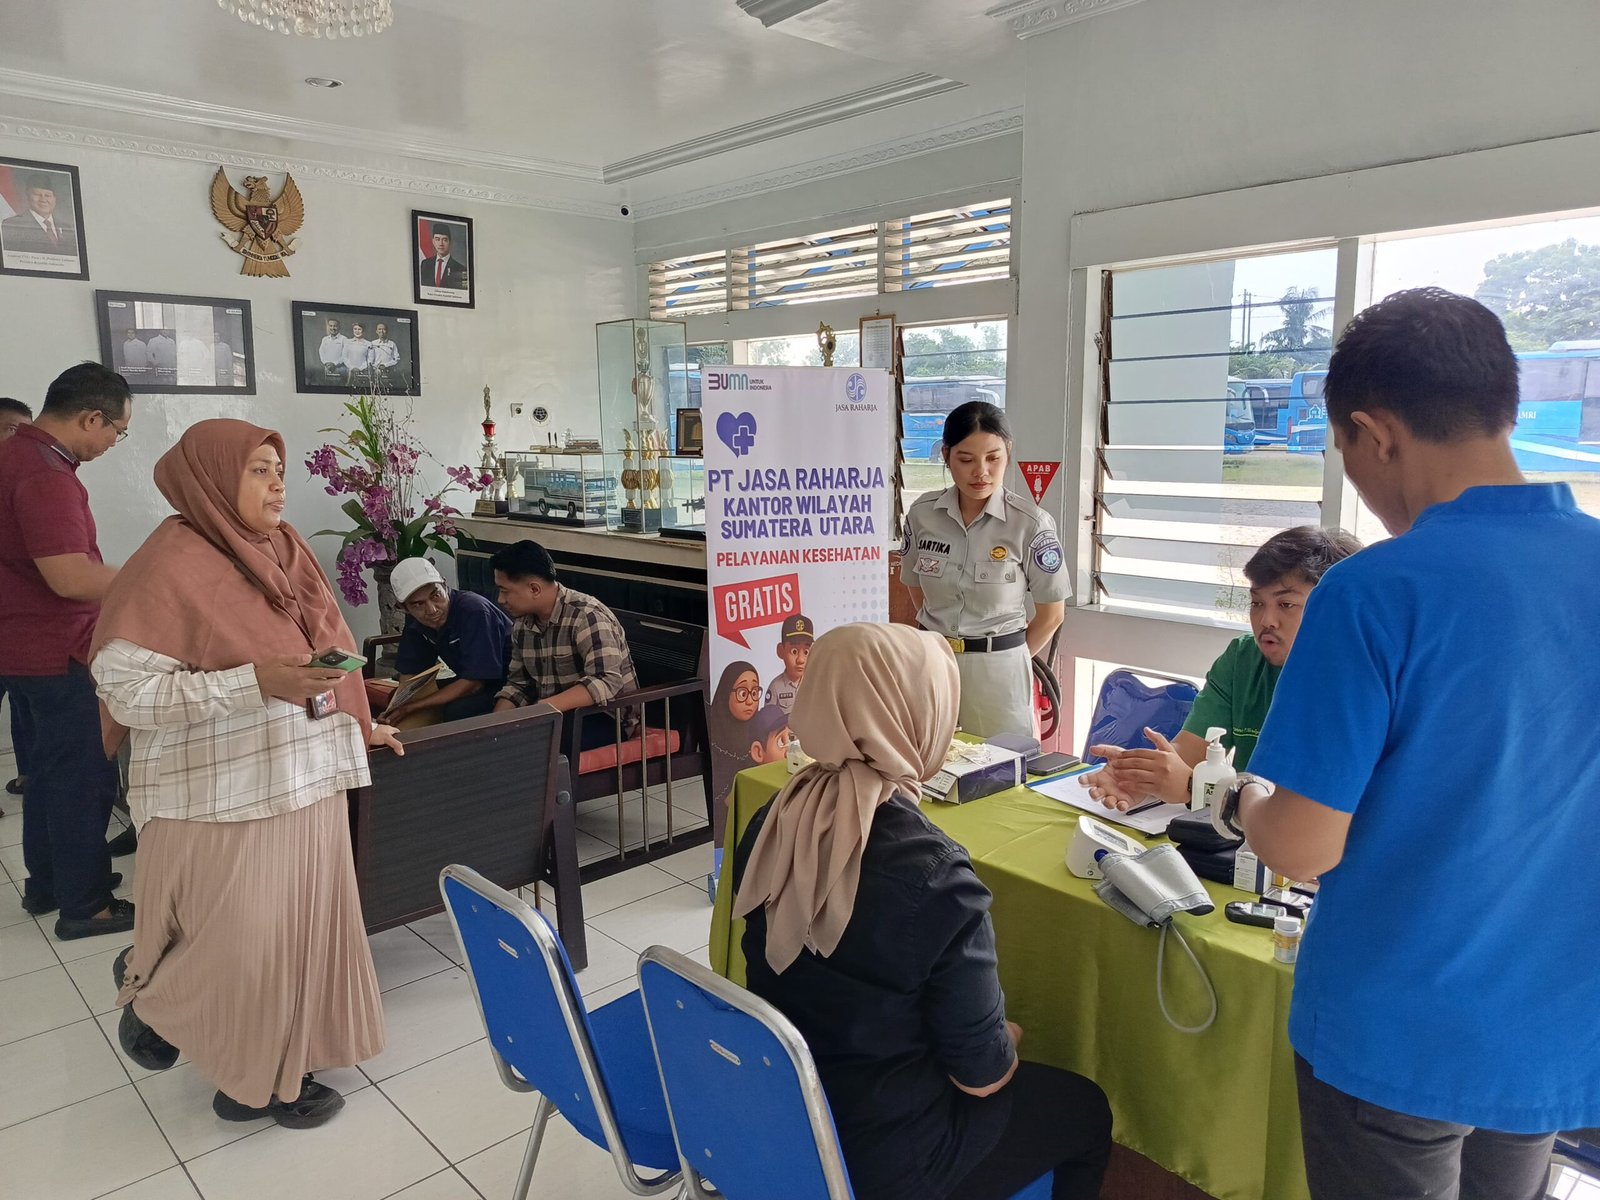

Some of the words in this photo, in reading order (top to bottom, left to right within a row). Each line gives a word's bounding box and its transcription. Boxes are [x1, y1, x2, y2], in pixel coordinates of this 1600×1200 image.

[708, 373, 749, 390] BUMN
[835, 403, 849, 412] JASA
[849, 403, 878, 412] RAHARJA
[1026, 464, 1051, 472] APAB
[708, 469, 734, 493] PT
[738, 468, 791, 492] JASA
[796, 466, 885, 490] RAHARJA
[723, 496, 792, 517] KANTOR
[796, 494, 872, 515] WILAYAH
[721, 518, 813, 539] SUMATERA
[820, 516, 875, 536] UTARA
[716, 549, 800, 567] PELAYANAN
[803, 546, 881, 564] KESEHATAN
[918, 538, 951, 555] SARTIKA
[724, 582, 794, 623] GRATIS
